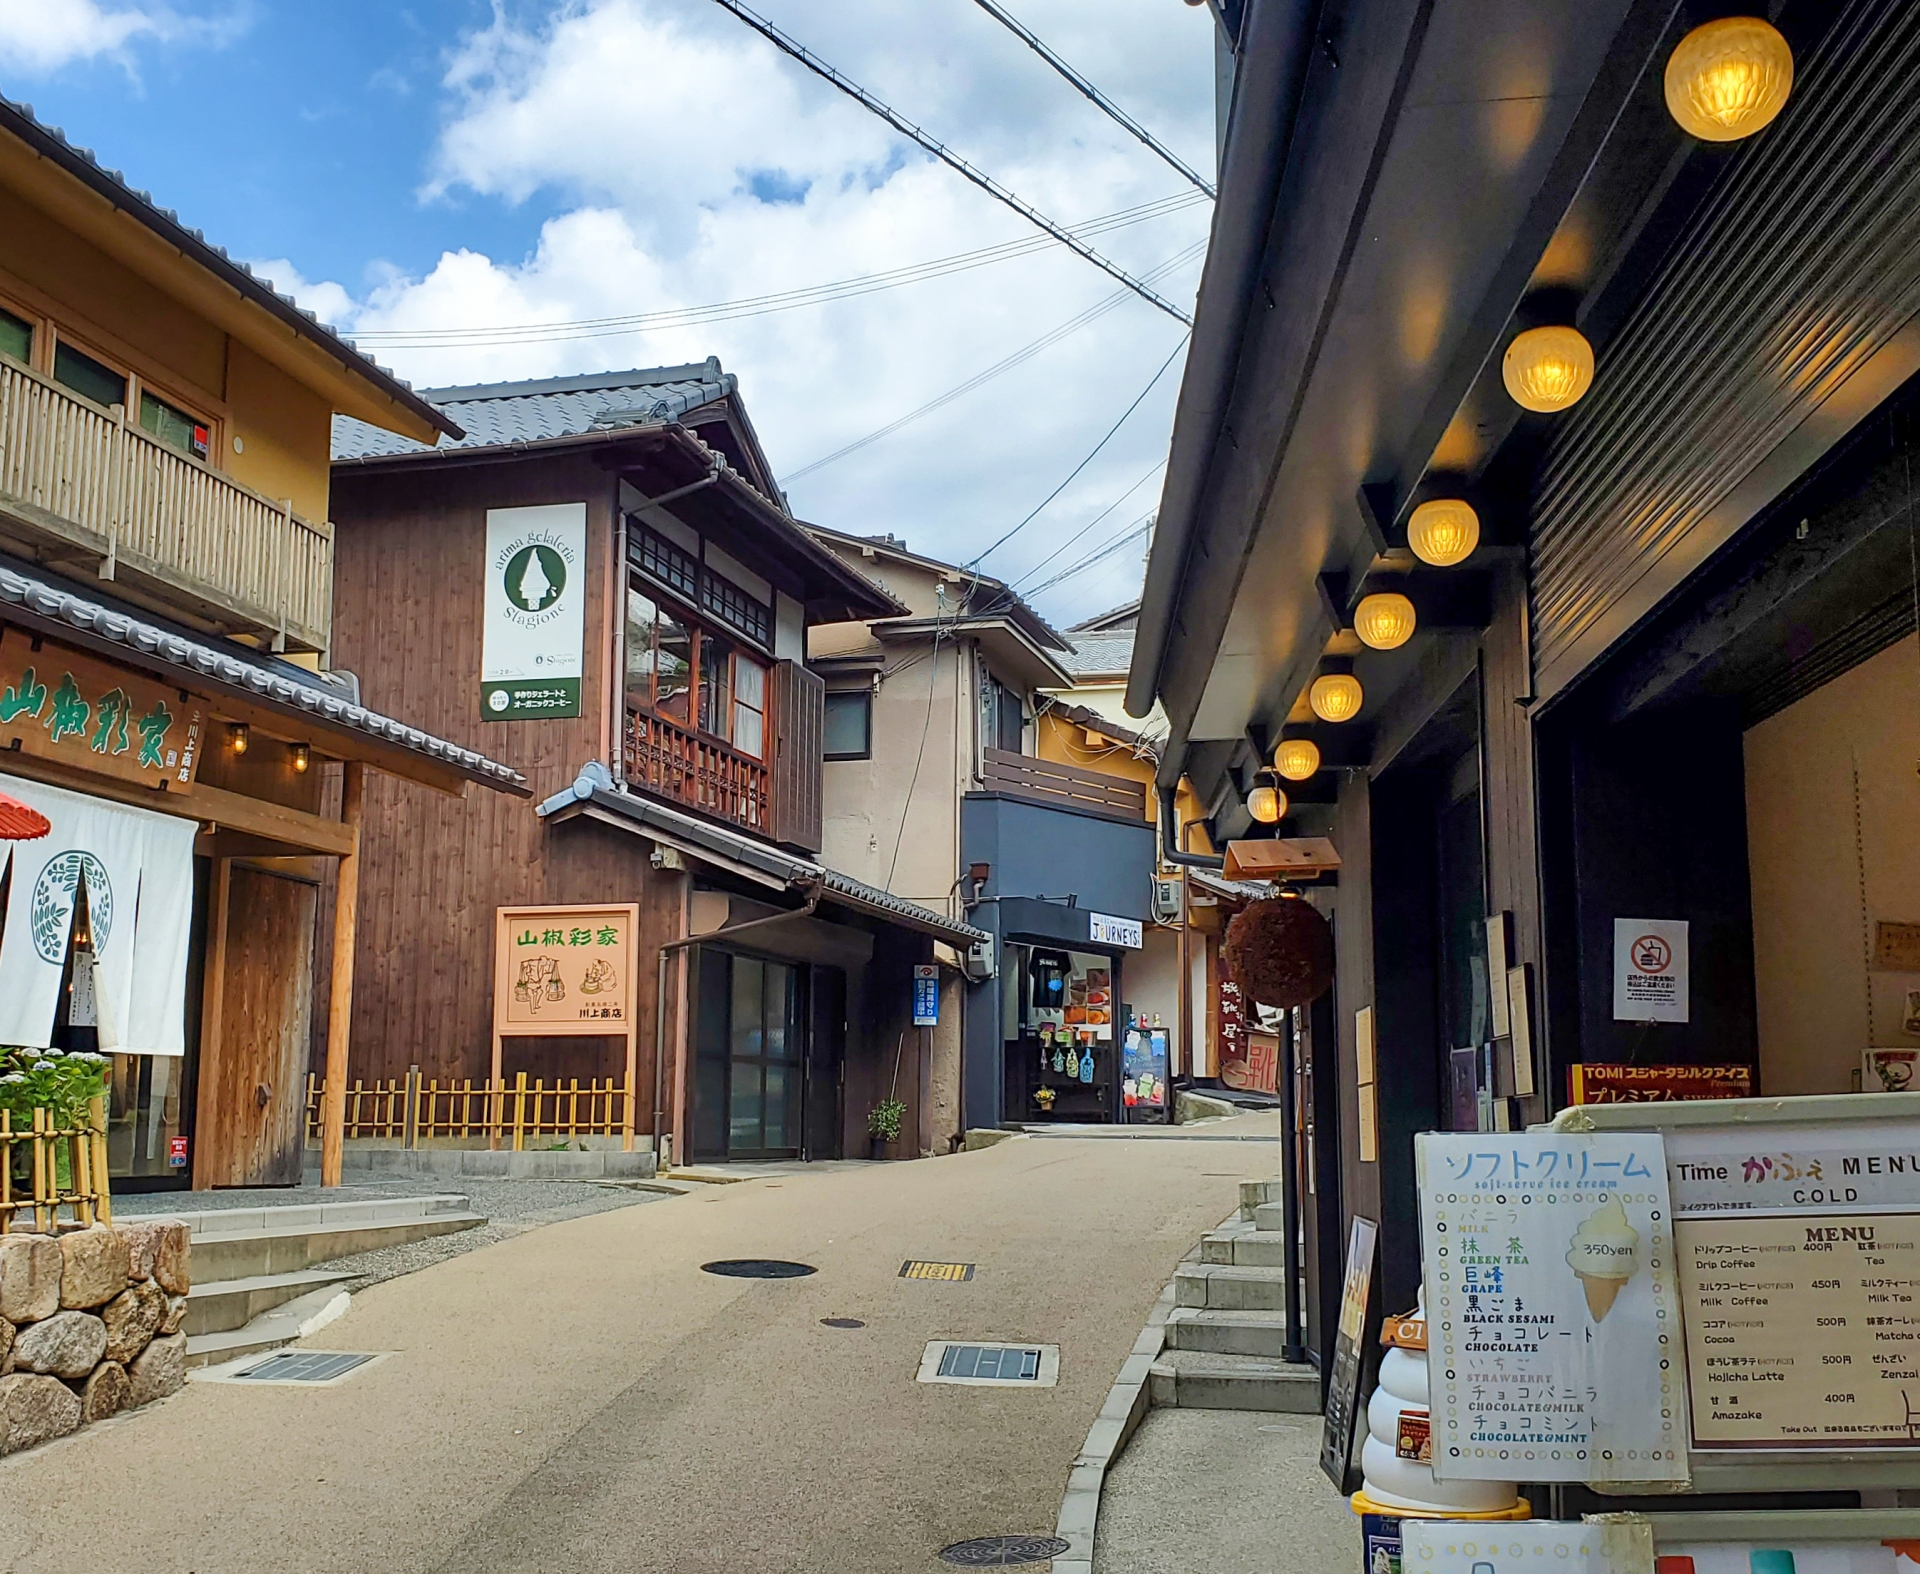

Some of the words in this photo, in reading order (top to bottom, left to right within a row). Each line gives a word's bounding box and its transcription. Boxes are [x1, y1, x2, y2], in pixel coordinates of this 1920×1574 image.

[495, 537, 524, 571] arima
[503, 603, 567, 630] Stagione
[514, 689, 567, 699] 手作りジェラートと
[513, 699, 573, 708] オーガニックコーヒー
[0, 666, 173, 768] 山椒彩家
[517, 925, 619, 947] 山椒彩家
[579, 1008, 622, 1019] 川上商店
[1584, 1067, 1623, 1080] TOMI
[1446, 1150, 1652, 1181] ソフトクリーム
[1677, 1163, 1728, 1182] Time
[1550, 1179, 1570, 1189] ice
[1576, 1179, 1618, 1190] cream
[1793, 1188, 1858, 1204] COLD
[1460, 1208, 1519, 1224] バニラ
[1458, 1225, 1489, 1234] MILK
[1805, 1226, 1875, 1242] MENU
[1583, 1244, 1633, 1257] 350yen
[1803, 1242, 1833, 1252] 400円
[1459, 1255, 1501, 1265] GREEN
[1506, 1255, 1529, 1265] TEA
[1696, 1260, 1717, 1270] Drip
[1720, 1259, 1756, 1269] Coffee
[1865, 1256, 1885, 1265] Tea
[1465, 1266, 1505, 1283] 巨峰
[1461, 1284, 1503, 1294] GRAPE
[1811, 1279, 1841, 1289] 450円
[1700, 1297, 1723, 1307] Milk
[1731, 1296, 1769, 1306] Coffee
[1868, 1294, 1890, 1303] Milk
[1892, 1293, 1913, 1302] Tea
[1466, 1295, 1526, 1313] 黒ごま
[1463, 1314, 1504, 1324] BLACK
[1507, 1314, 1556, 1324] SESAMI
[1816, 1317, 1847, 1327] 500円
[1468, 1325, 1593, 1343] チョコレート
[1704, 1335, 1735, 1344] Cocoa
[1875, 1332, 1914, 1341] Matcha
[1465, 1343, 1539, 1353] CHOCOLATE
[1468, 1357, 1530, 1372] いちご
[1821, 1354, 1852, 1364] 500円
[1872, 1354, 1907, 1364] ぜんざい
[1466, 1373, 1552, 1383] STRAWBERRY
[1752, 1372, 1785, 1382] Latte
[1471, 1384, 1598, 1402] チョコバニラ
[1824, 1393, 1855, 1403] 400円
[1468, 1402, 1585, 1413] CHOCOLATE&MILK
[1711, 1410, 1763, 1420] Amazake
[1473, 1414, 1598, 1431] チョコミント
[1781, 1425, 1801, 1433] Take
[1802, 1425, 1818, 1433] Out
[1470, 1432, 1588, 1443] CHOCOLATE&MINT
